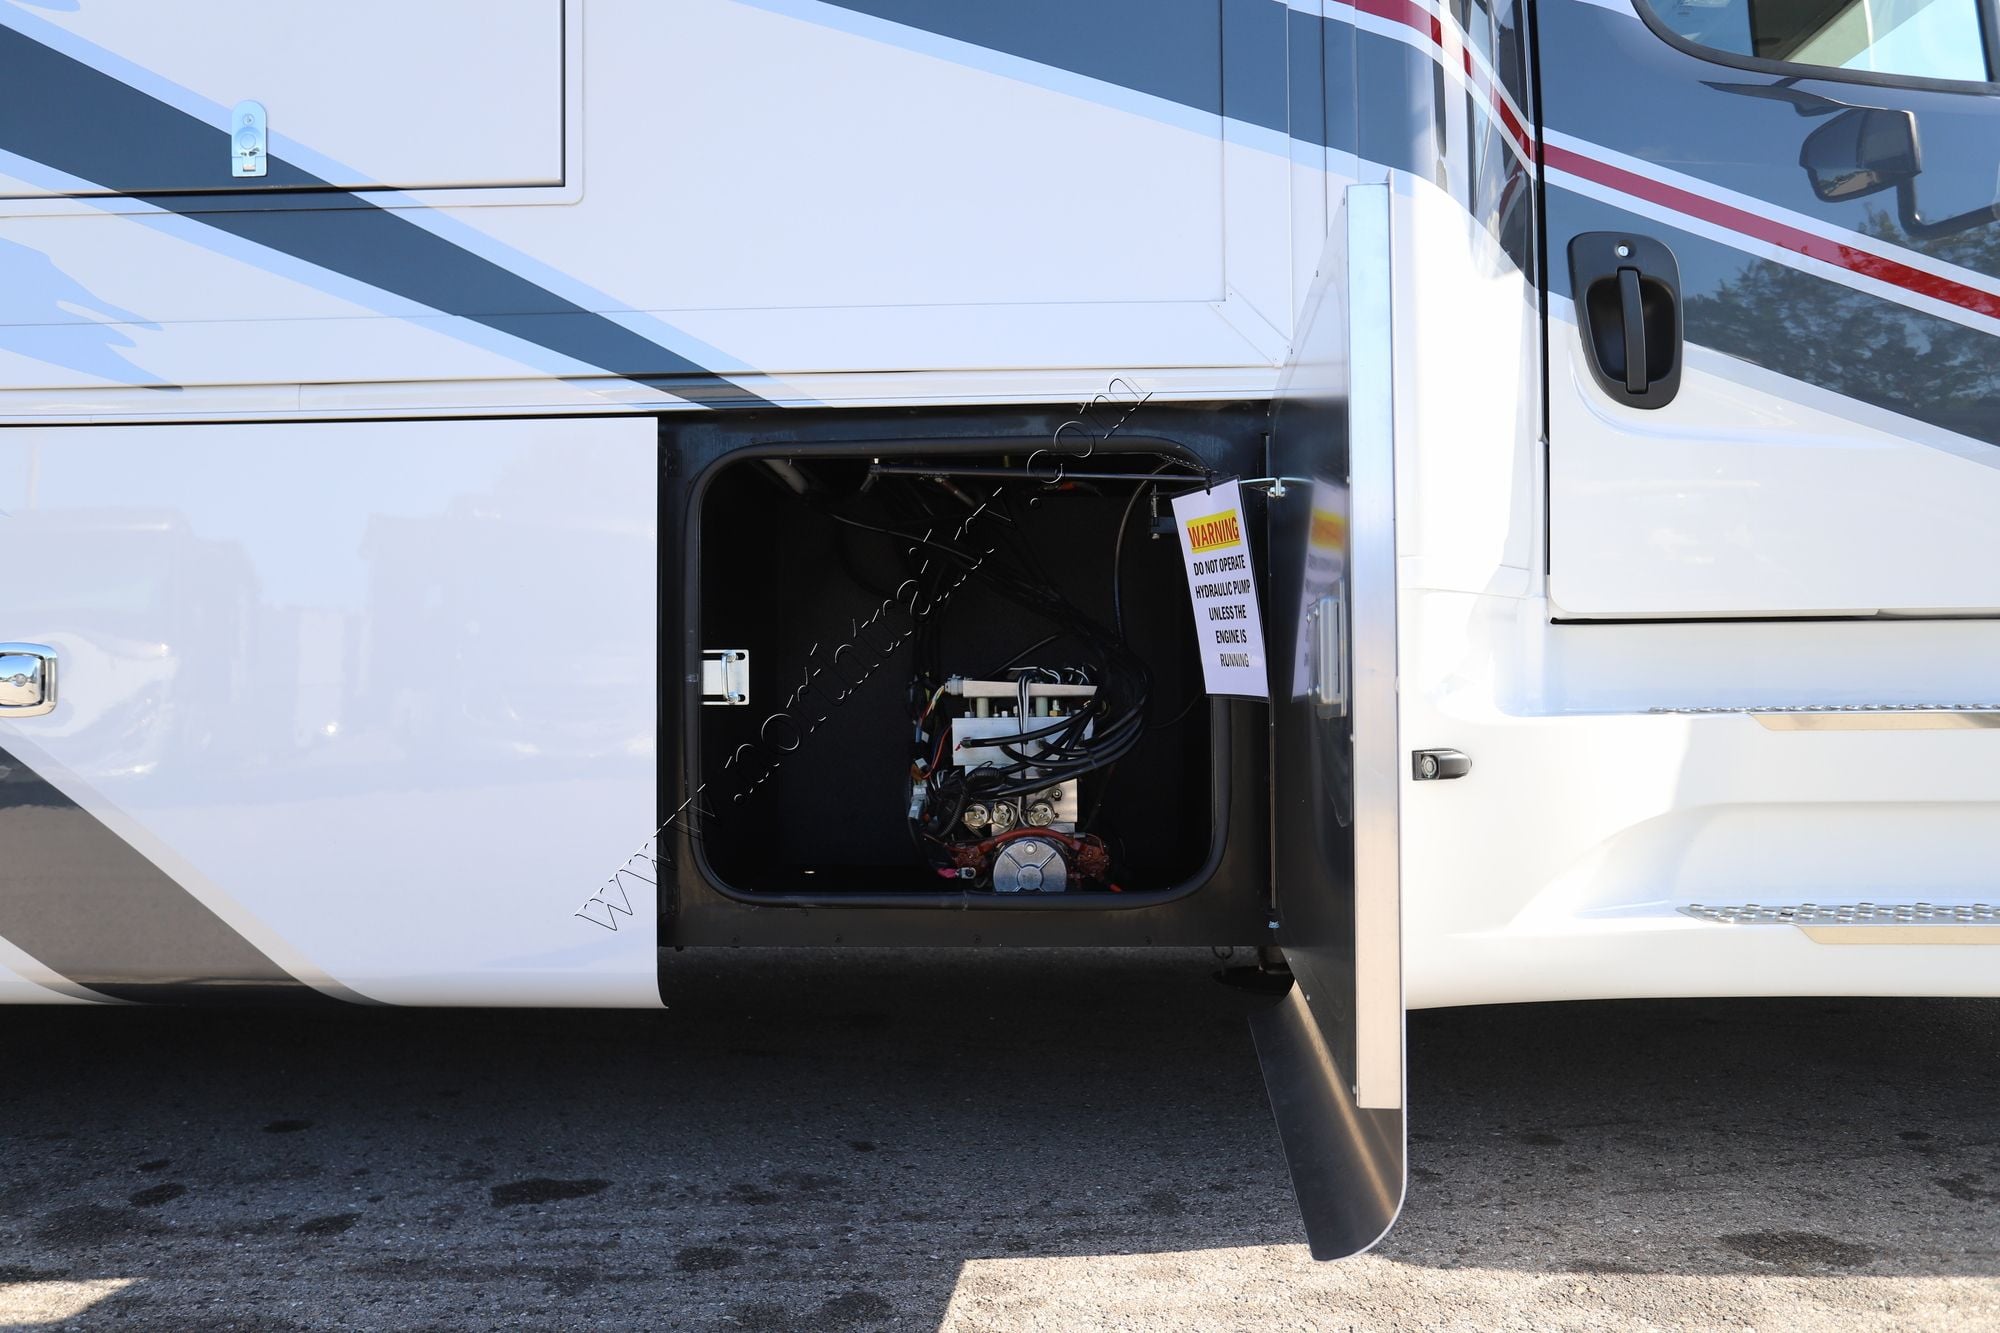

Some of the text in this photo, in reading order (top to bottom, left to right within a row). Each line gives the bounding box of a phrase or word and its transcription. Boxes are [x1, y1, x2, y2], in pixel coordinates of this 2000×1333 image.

[1187, 516, 1240, 547] WARNING
[1193, 554, 1246, 576] DO NOT OPERATE
[1195, 579, 1251, 599] HYDRAULIC PUMP
[1208, 604, 1247, 621] UNLESS THE
[1215, 629, 1247, 644] ENGINE IS
[1220, 653, 1249, 667] RUNNING
